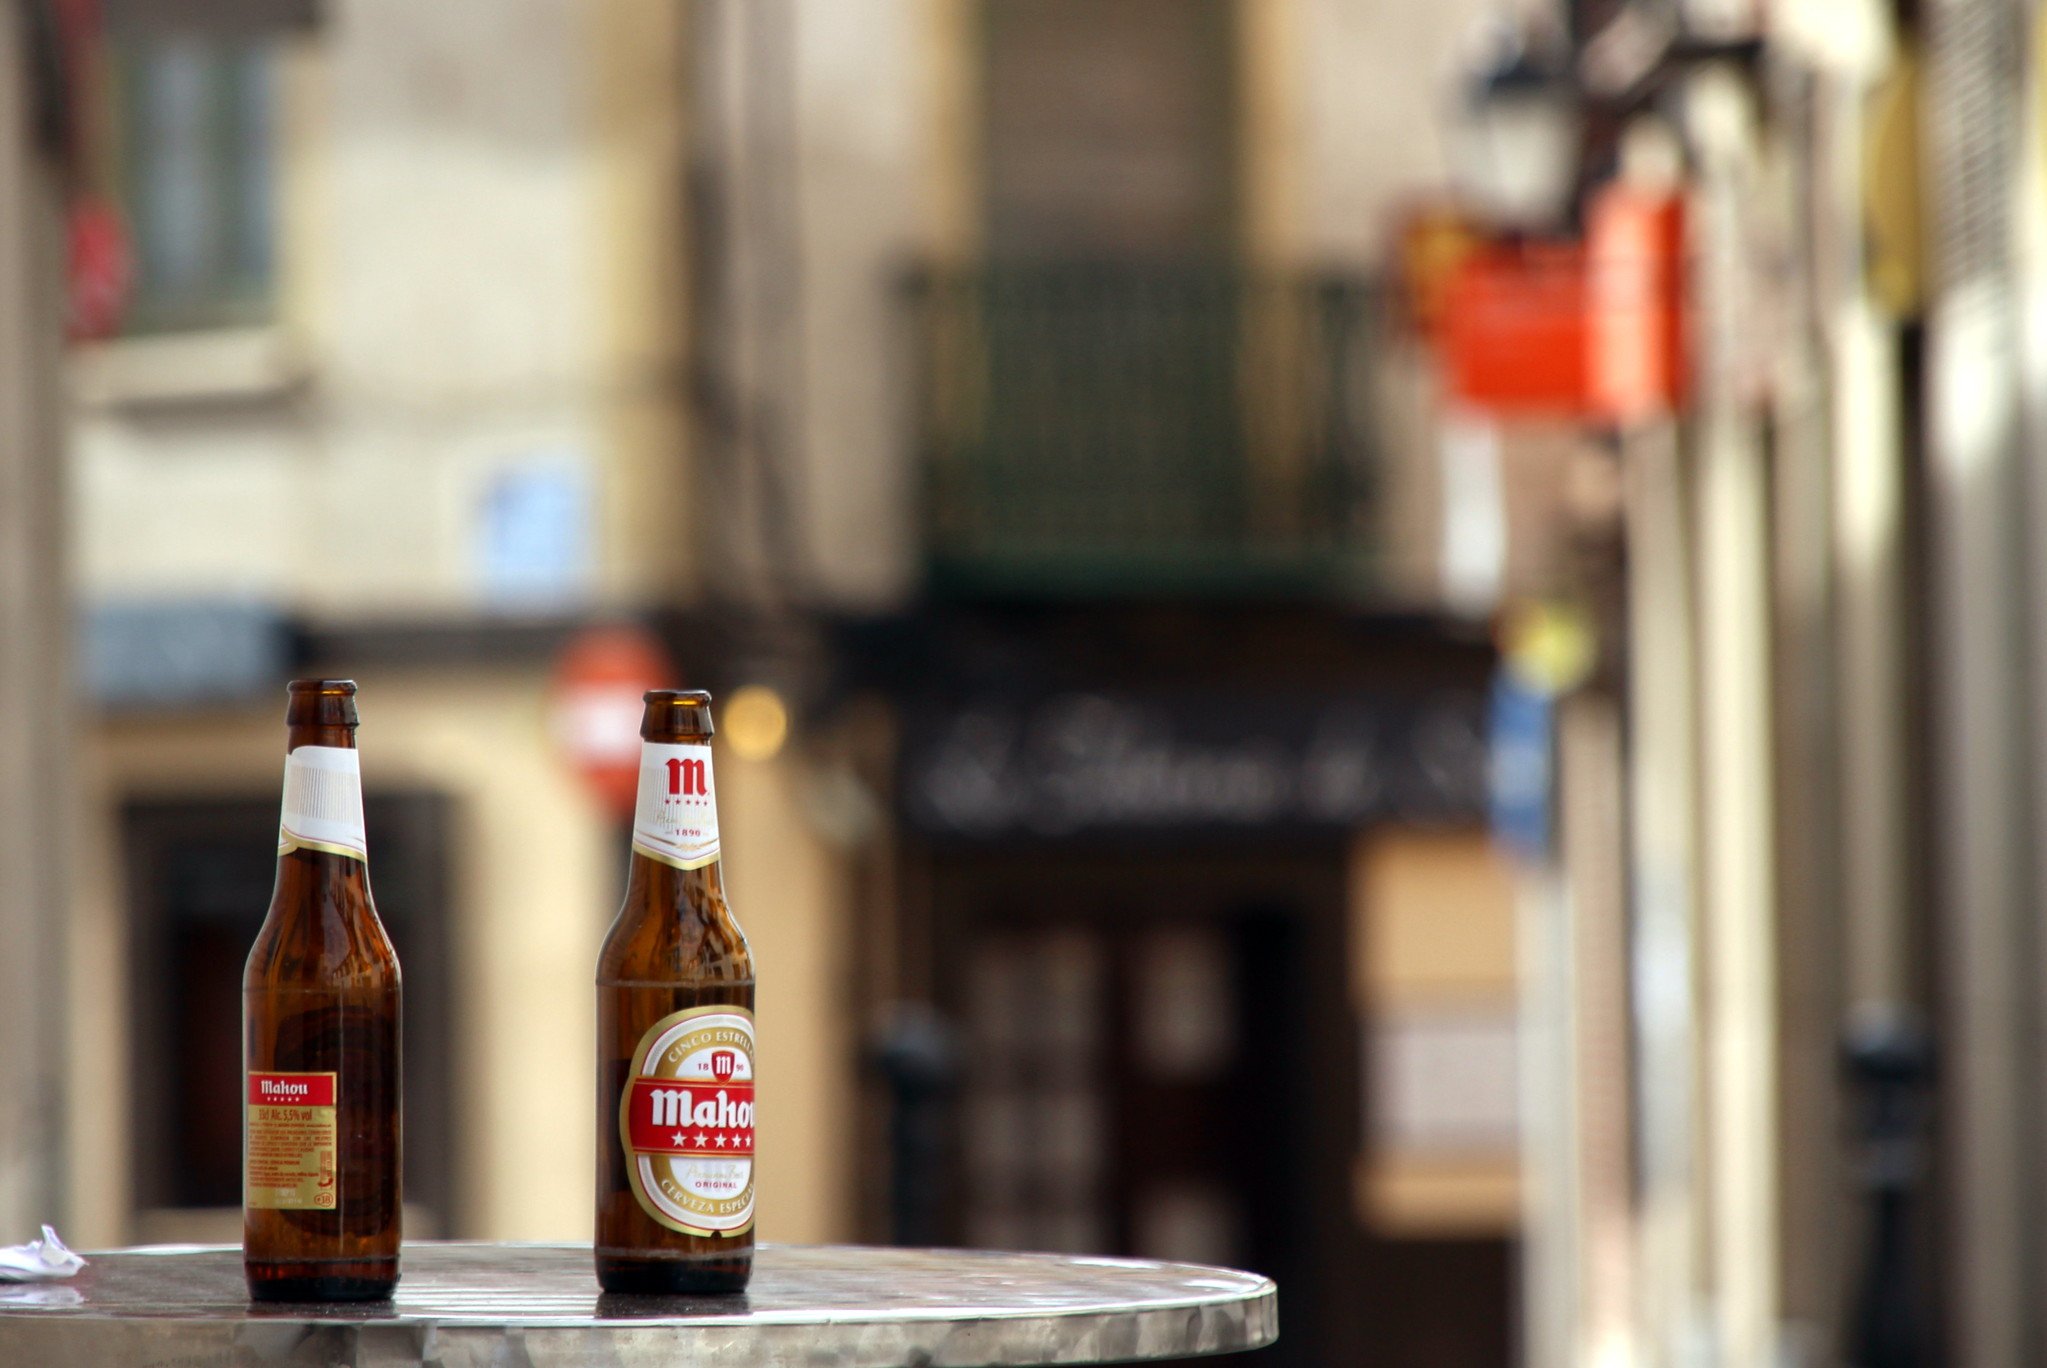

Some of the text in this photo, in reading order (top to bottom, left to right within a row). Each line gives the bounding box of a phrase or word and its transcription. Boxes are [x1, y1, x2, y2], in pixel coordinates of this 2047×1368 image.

[676, 829, 701, 837] 1890
[669, 1033, 712, 1062] CINCO
[698, 1063, 709, 1071] 18
[261, 1080, 308, 1094] Mahou
[662, 1179, 714, 1212] CERVEZA
